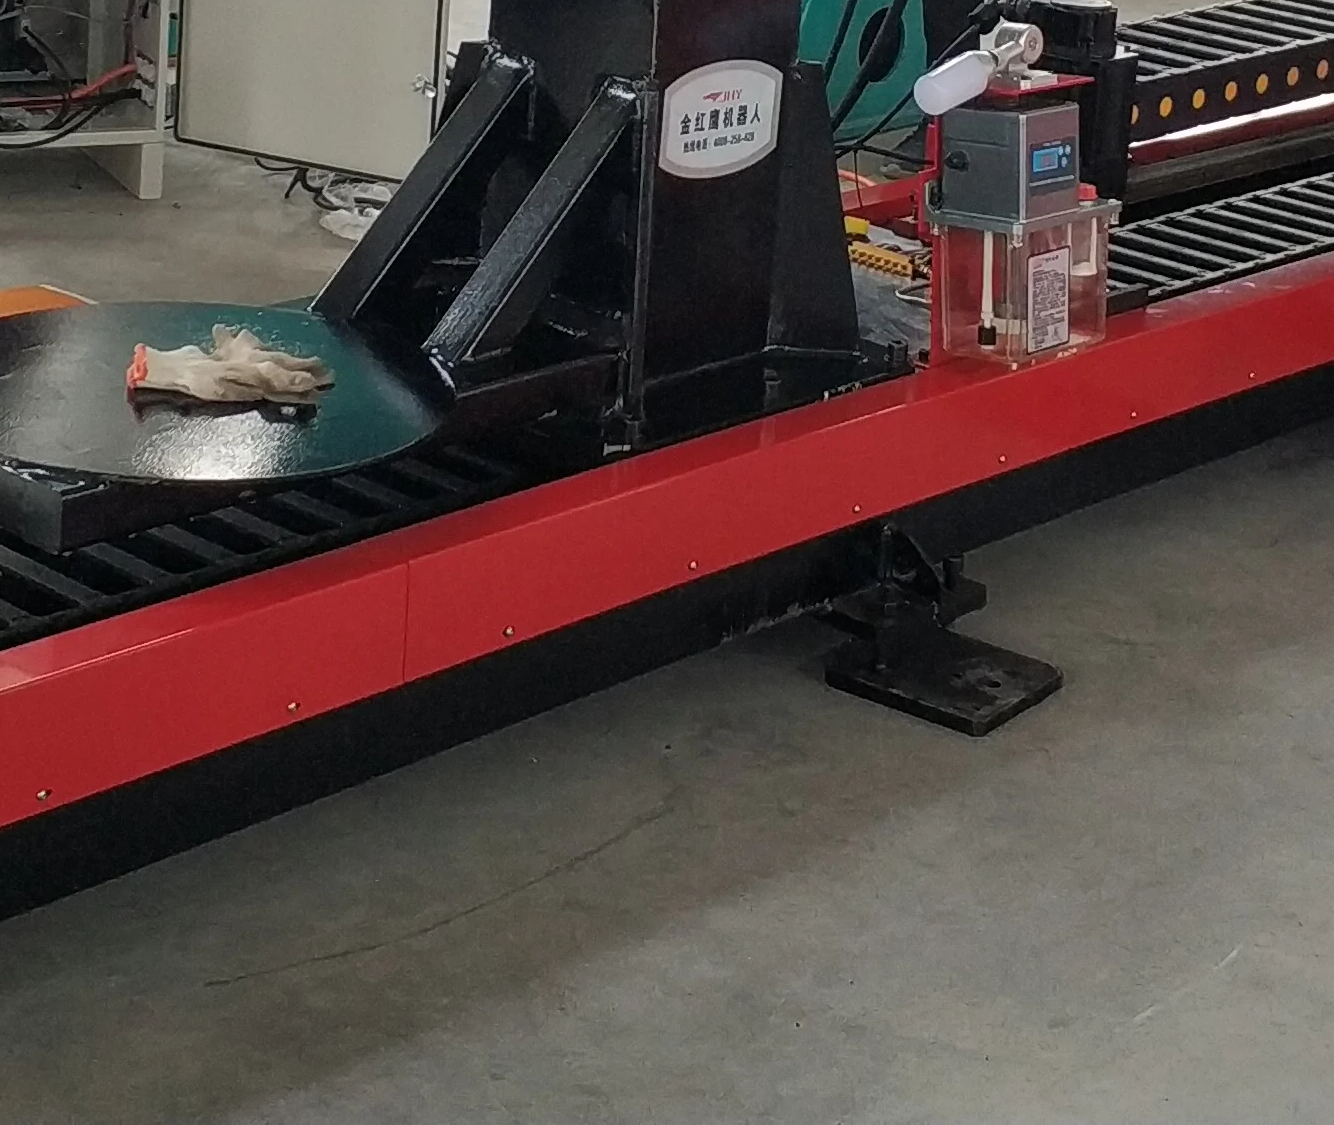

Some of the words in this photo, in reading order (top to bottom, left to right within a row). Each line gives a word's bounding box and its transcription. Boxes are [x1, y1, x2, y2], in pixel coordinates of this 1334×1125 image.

[679, 103, 761, 136] 金红鹰机器人
